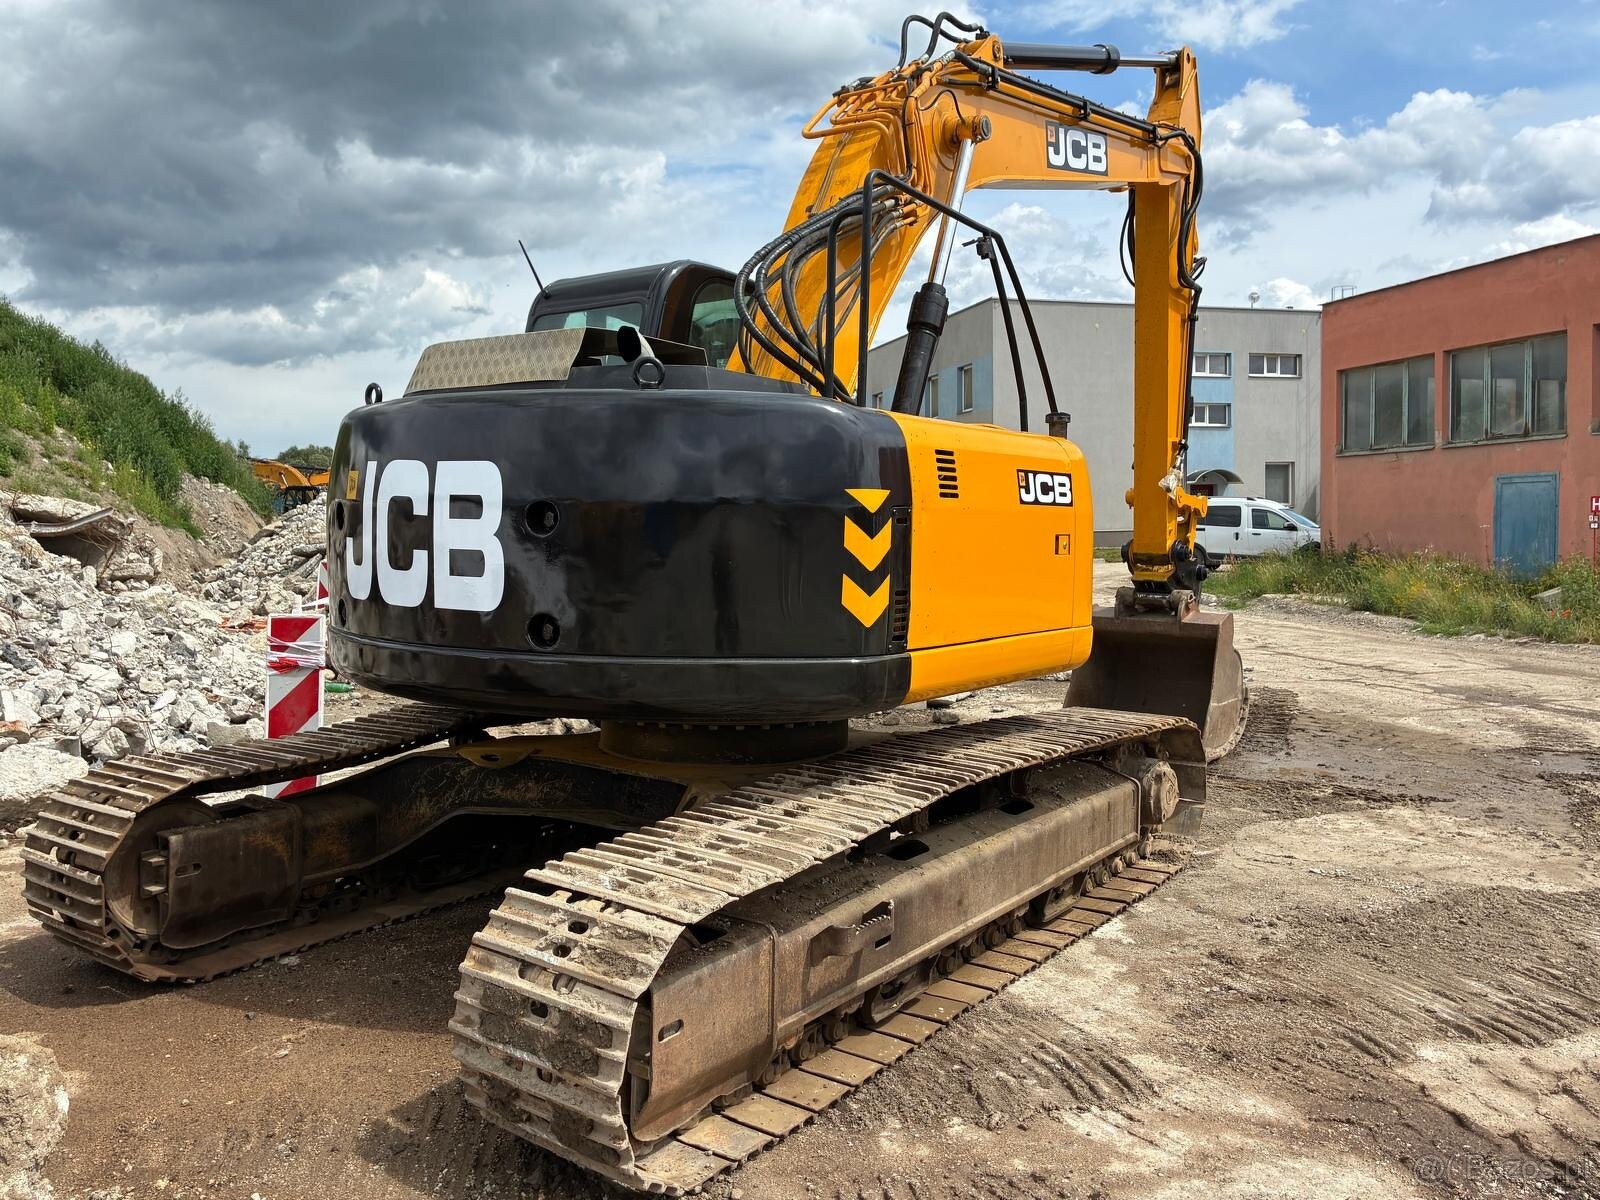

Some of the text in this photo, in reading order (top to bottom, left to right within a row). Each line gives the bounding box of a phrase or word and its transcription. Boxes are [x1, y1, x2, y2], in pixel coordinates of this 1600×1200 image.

[1047, 127, 1107, 172] JCB
[1019, 472, 1072, 504] JCB
[346, 459, 505, 612] JCB
